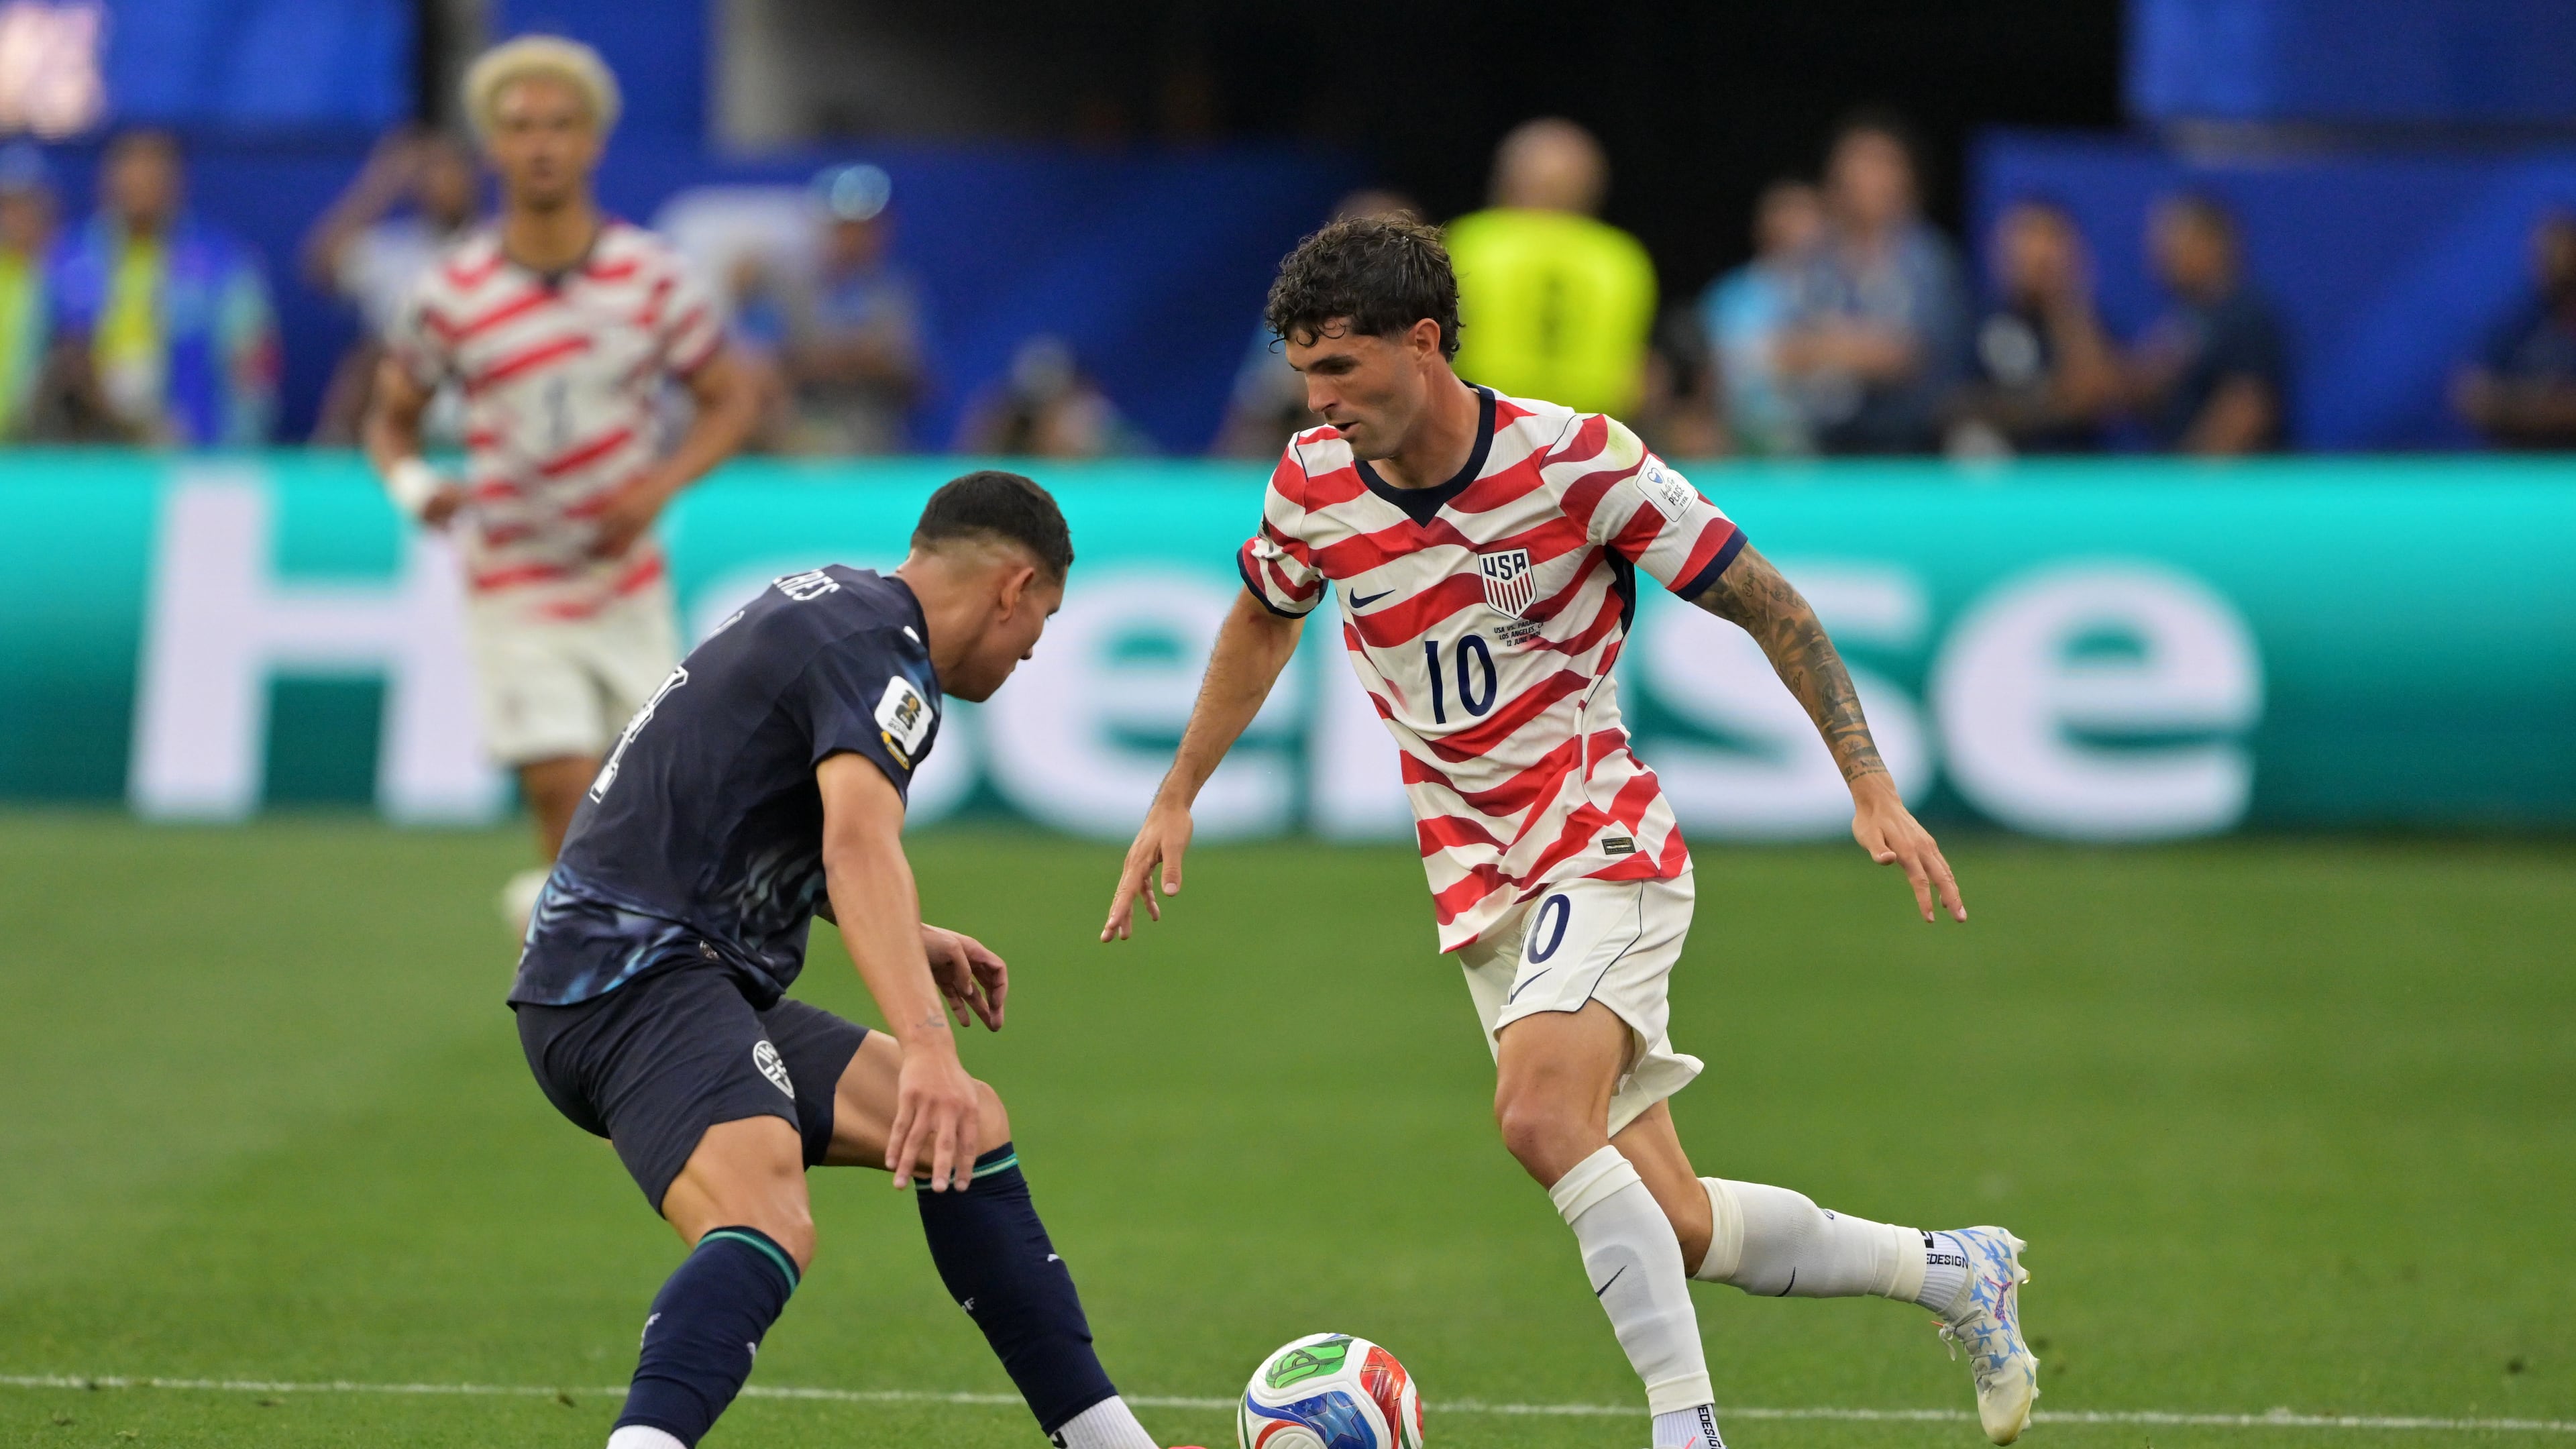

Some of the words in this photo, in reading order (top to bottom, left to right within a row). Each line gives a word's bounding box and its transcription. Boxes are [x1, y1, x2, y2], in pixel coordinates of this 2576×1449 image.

[1668, 484, 1685, 506] PEACE
[1680, 496, 1689, 507] FIFA
[1483, 553, 1527, 580] USA
[1514, 636, 1528, 645] JUNE
[1425, 634, 1497, 724] 10
